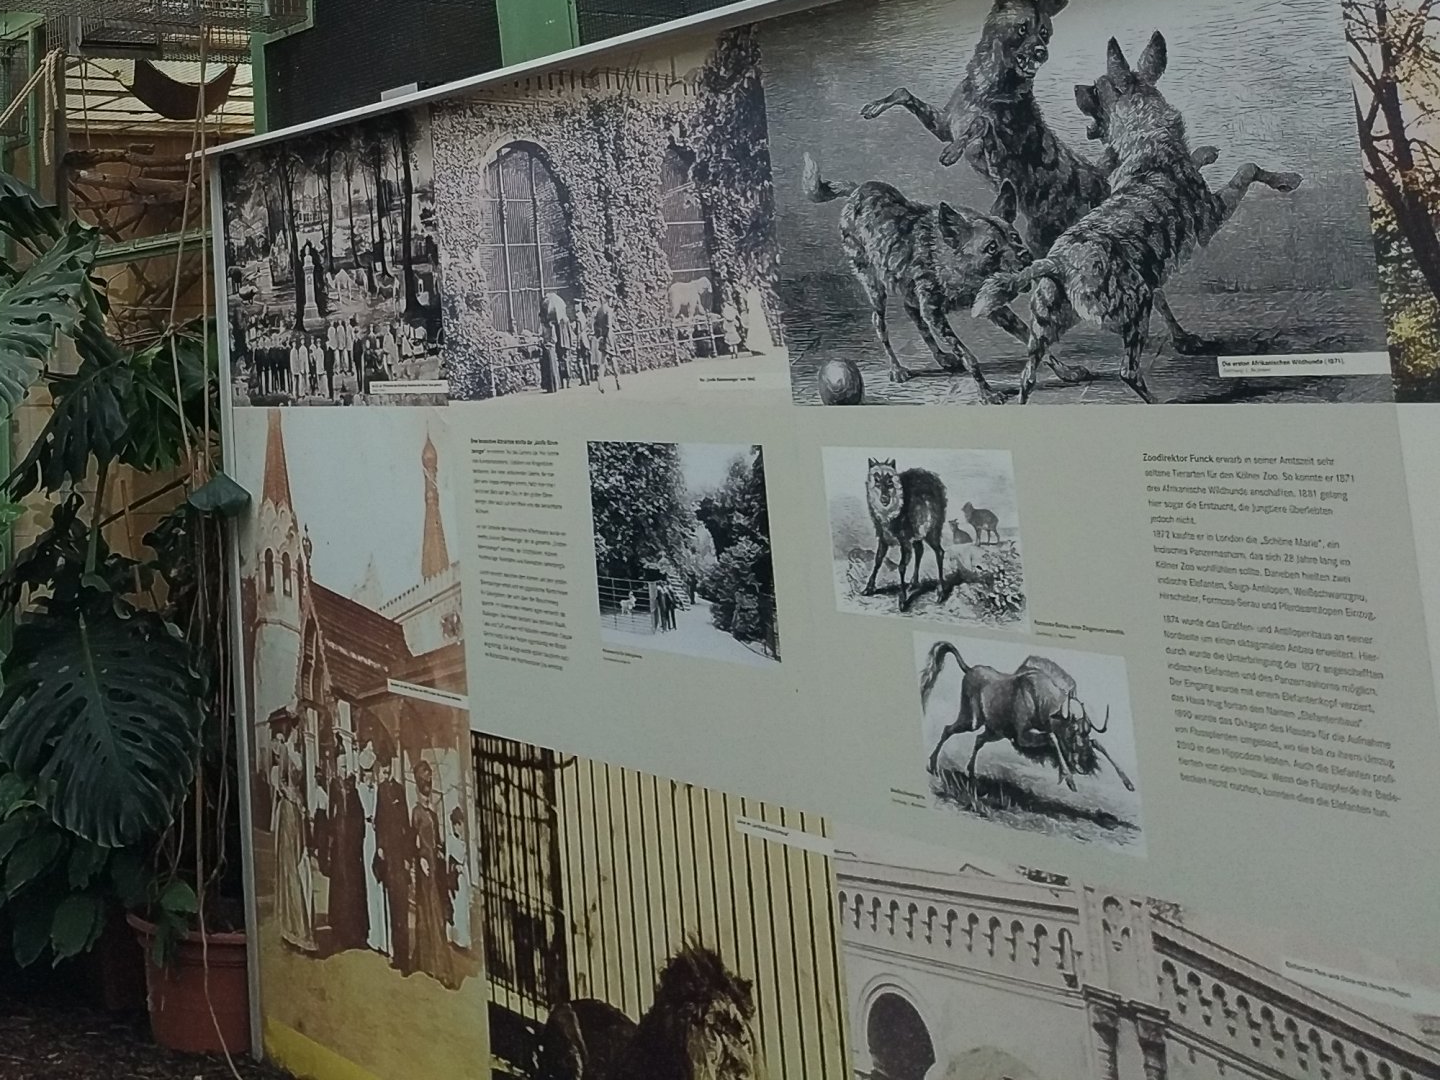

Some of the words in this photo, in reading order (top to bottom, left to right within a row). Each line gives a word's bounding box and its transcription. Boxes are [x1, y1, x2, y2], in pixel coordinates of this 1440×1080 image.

[1143, 453, 1187, 462] Zoodirektor
[1190, 454, 1214, 463] Funck
[1216, 456, 1242, 464] erwarb
[1280, 457, 1314, 465] Amtszeit
[1317, 457, 1334, 465] sehr
[1145, 469, 1170, 477] seltene
[1173, 469, 1205, 478] Tierarten
[1207, 470, 1217, 478] für
[1236, 471, 1260, 480] Kölner
[1283, 472, 1293, 481] So
[1295, 473, 1323, 482] konnte
[1336, 474, 1355, 483] 1871
[1162, 485, 1206, 494] Afrikanische
[1208, 486, 1247, 496] Wildhunde
[1299, 489, 1317, 497] 1881
[1320, 491, 1348, 502] gelang
[1148, 499, 1161, 507] hier
[1164, 501, 1184, 510] sogar
[1186, 501, 1197, 509] die
[1199, 501, 1237, 512] Erstzucht,
[1238, 503, 1249, 511] die
[1251, 504, 1287, 514] Jungtiere
[1289, 505, 1333, 515] überlebten
[1150, 515, 1174, 524] jedoch
